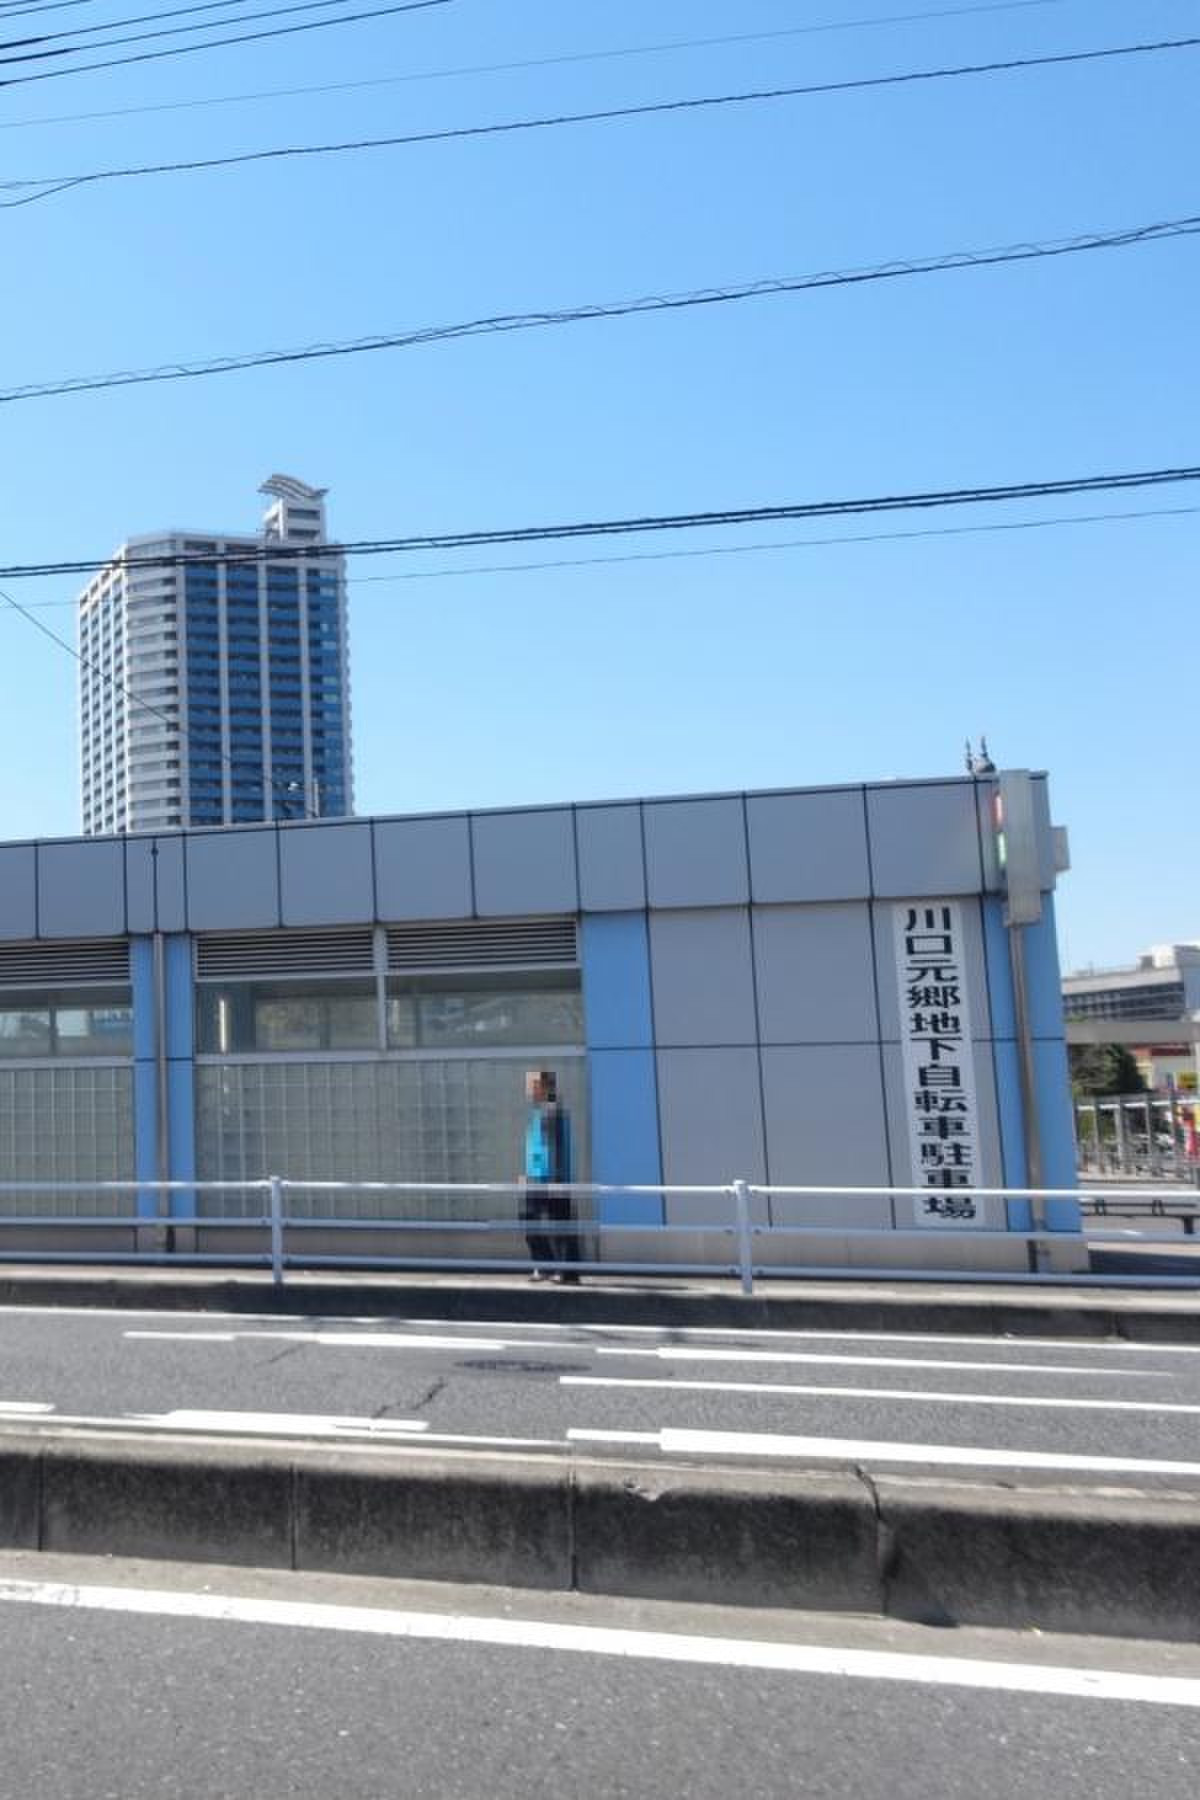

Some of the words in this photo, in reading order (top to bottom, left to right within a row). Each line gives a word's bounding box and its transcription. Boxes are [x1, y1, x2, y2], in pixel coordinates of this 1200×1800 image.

[904, 905, 977, 1219] 川口元郷地下自転車駐車場
